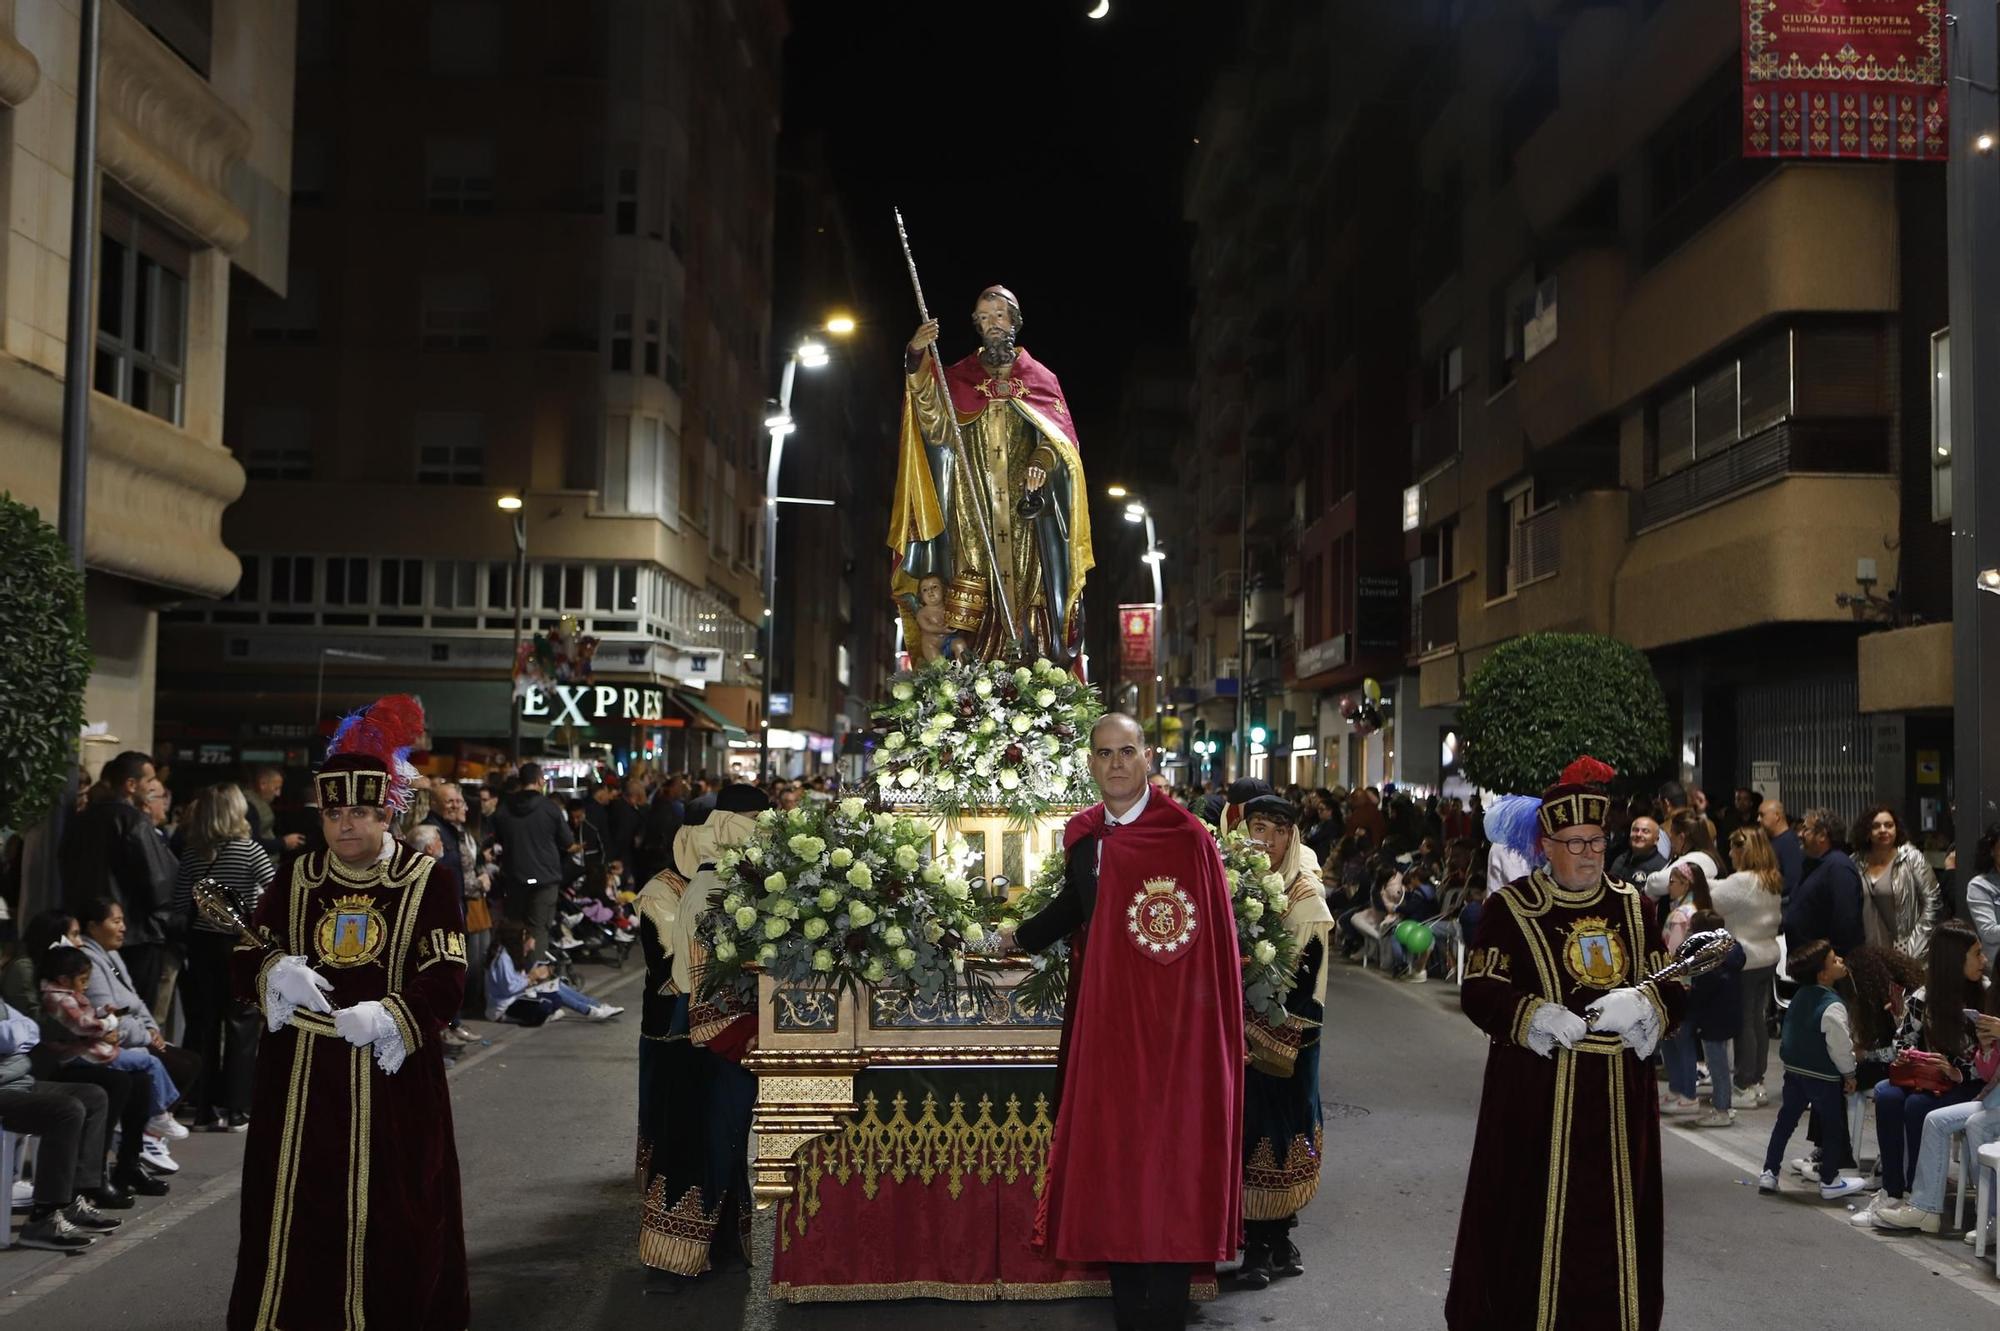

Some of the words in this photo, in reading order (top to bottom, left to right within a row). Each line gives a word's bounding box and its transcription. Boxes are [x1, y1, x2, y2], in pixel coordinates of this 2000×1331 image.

[1782, 14, 1828, 24] CIUDAD
[1831, 15, 1845, 25] DE
[1849, 15, 1911, 25] FRONTERA
[1782, 25, 1835, 34] Musulmanes
[1867, 27, 1912, 36] Cristianos
